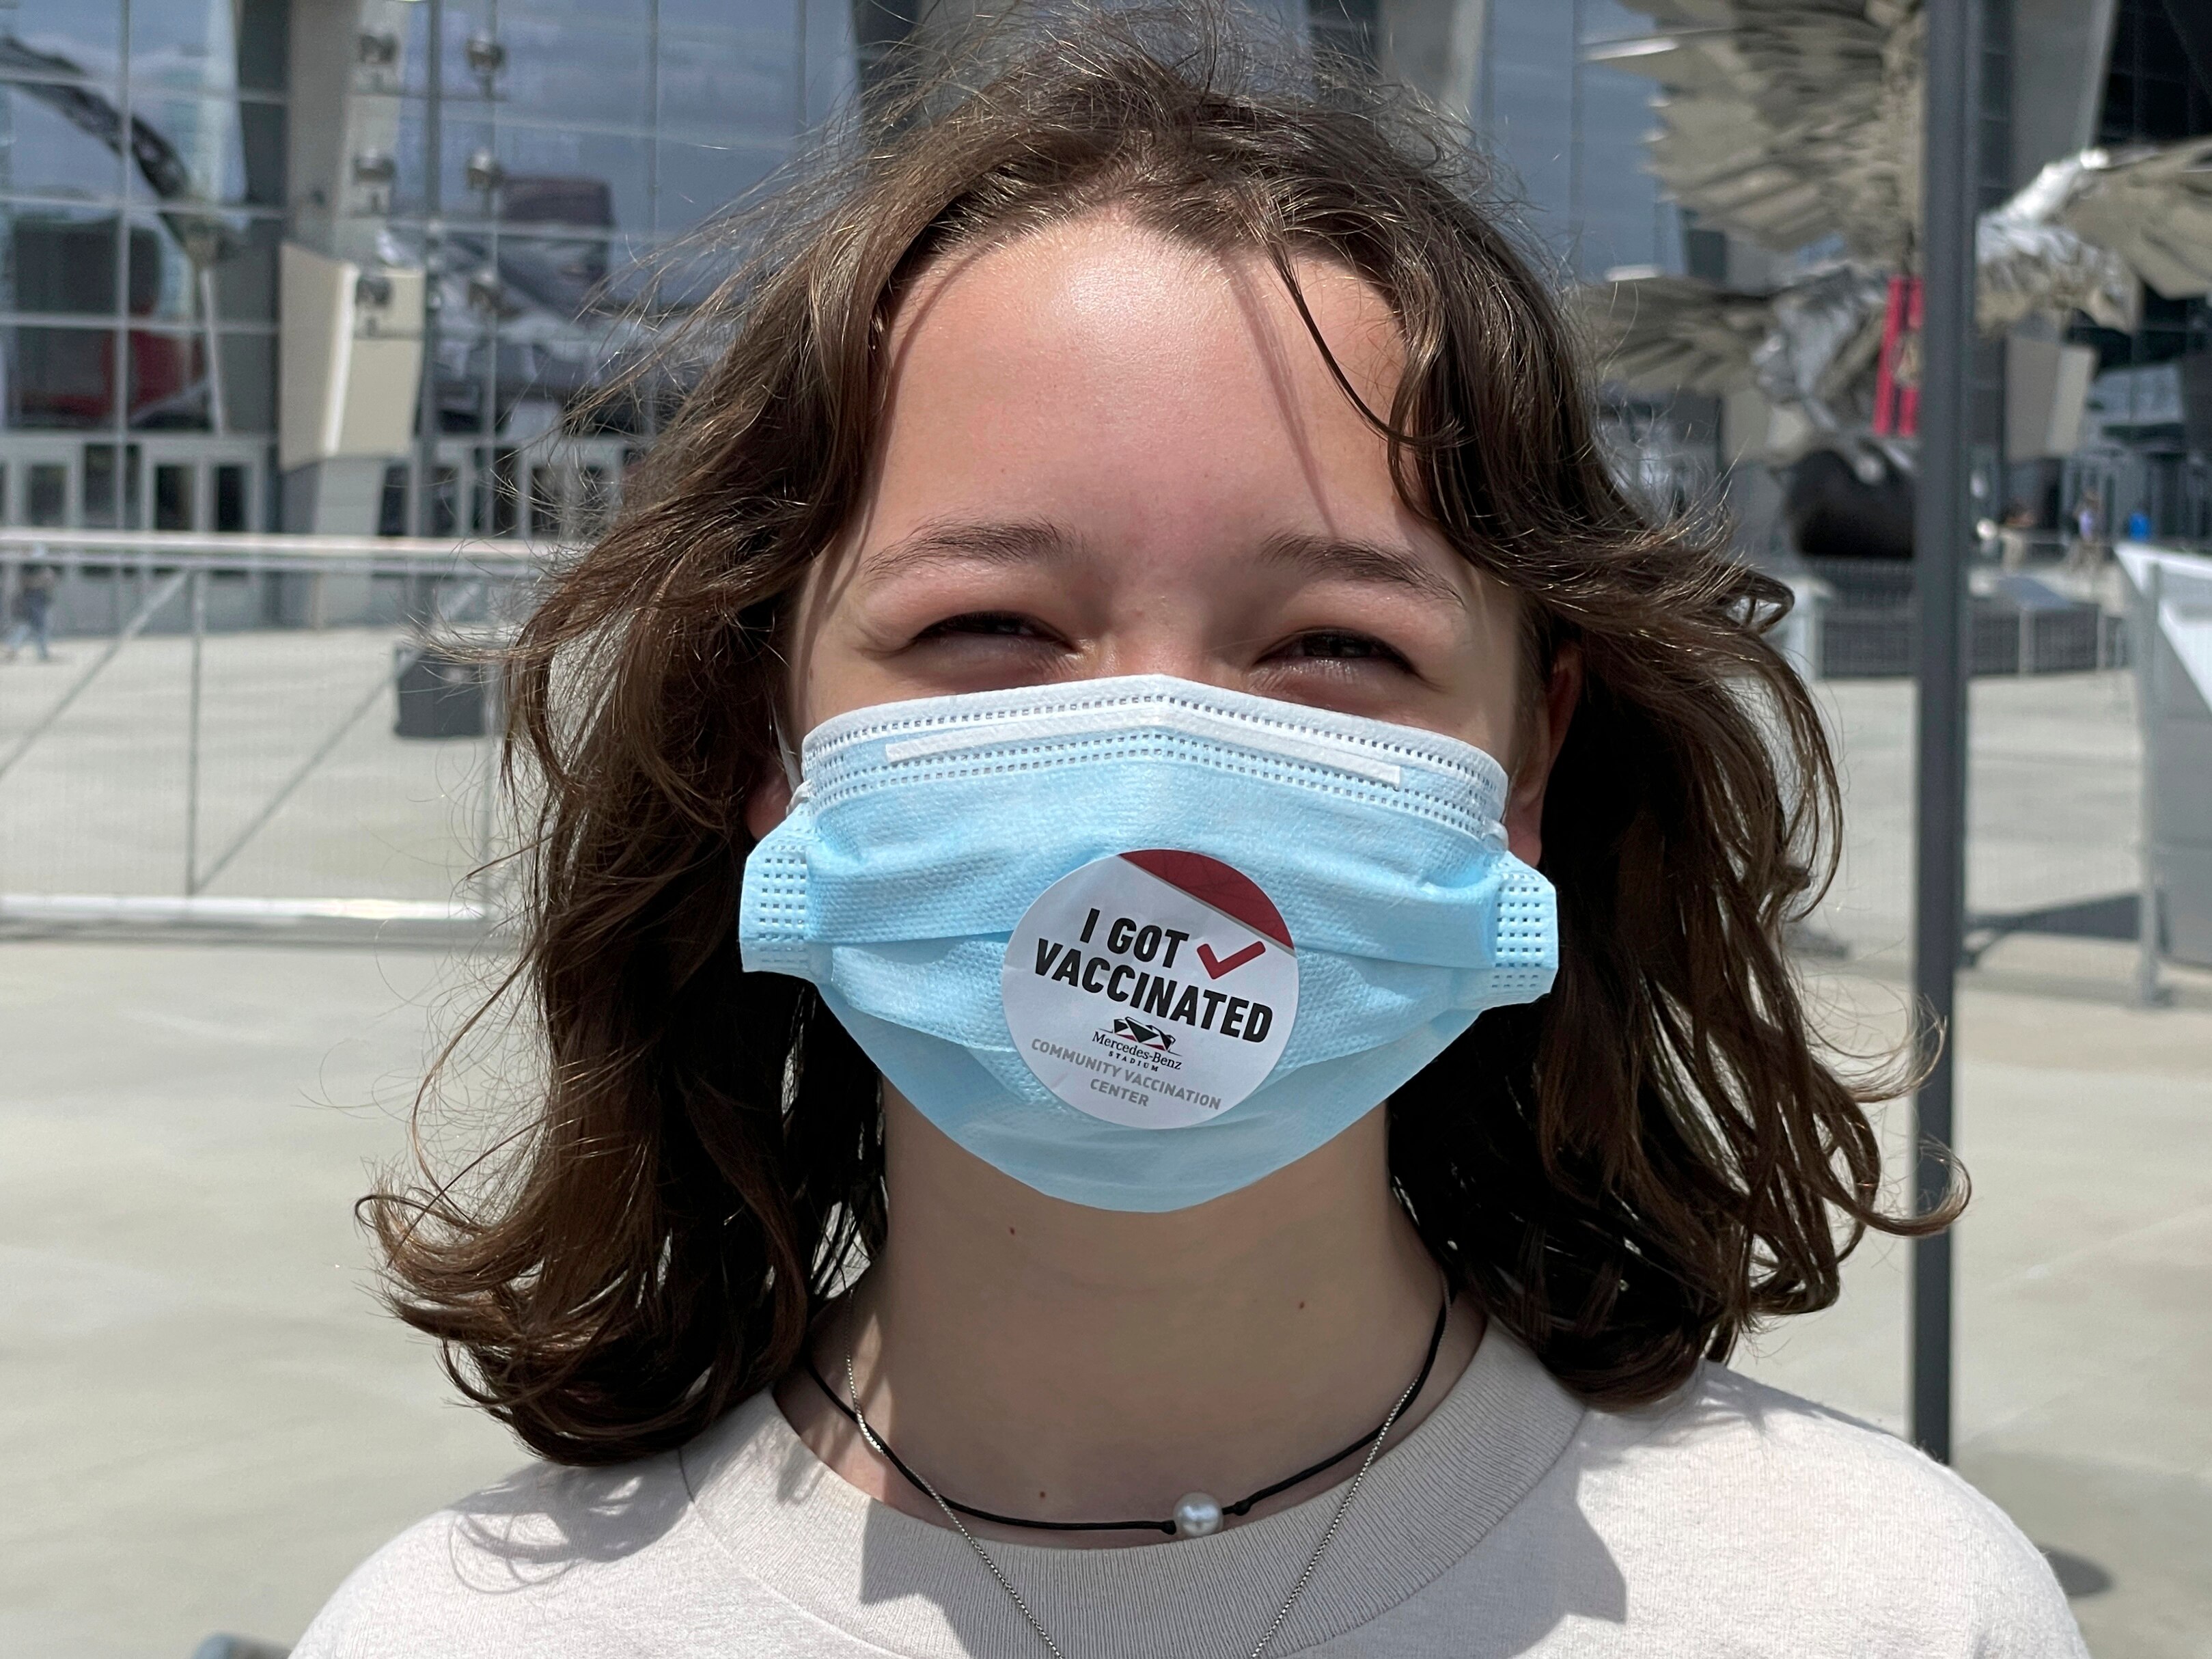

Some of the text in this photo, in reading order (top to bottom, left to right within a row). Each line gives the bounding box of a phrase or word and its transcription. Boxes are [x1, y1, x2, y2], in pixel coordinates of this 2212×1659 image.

[1079, 907, 1190, 969] I GOT
[1035, 937, 1274, 1043] VACCINATED
[1031, 1038, 1221, 1110] COMMUNITY VACCINATION
[1092, 1030, 1183, 1071] Mercedes-Benz
[1107, 1050, 1159, 1072] STADIUM
[1090, 1078, 1150, 1107] CENTER
